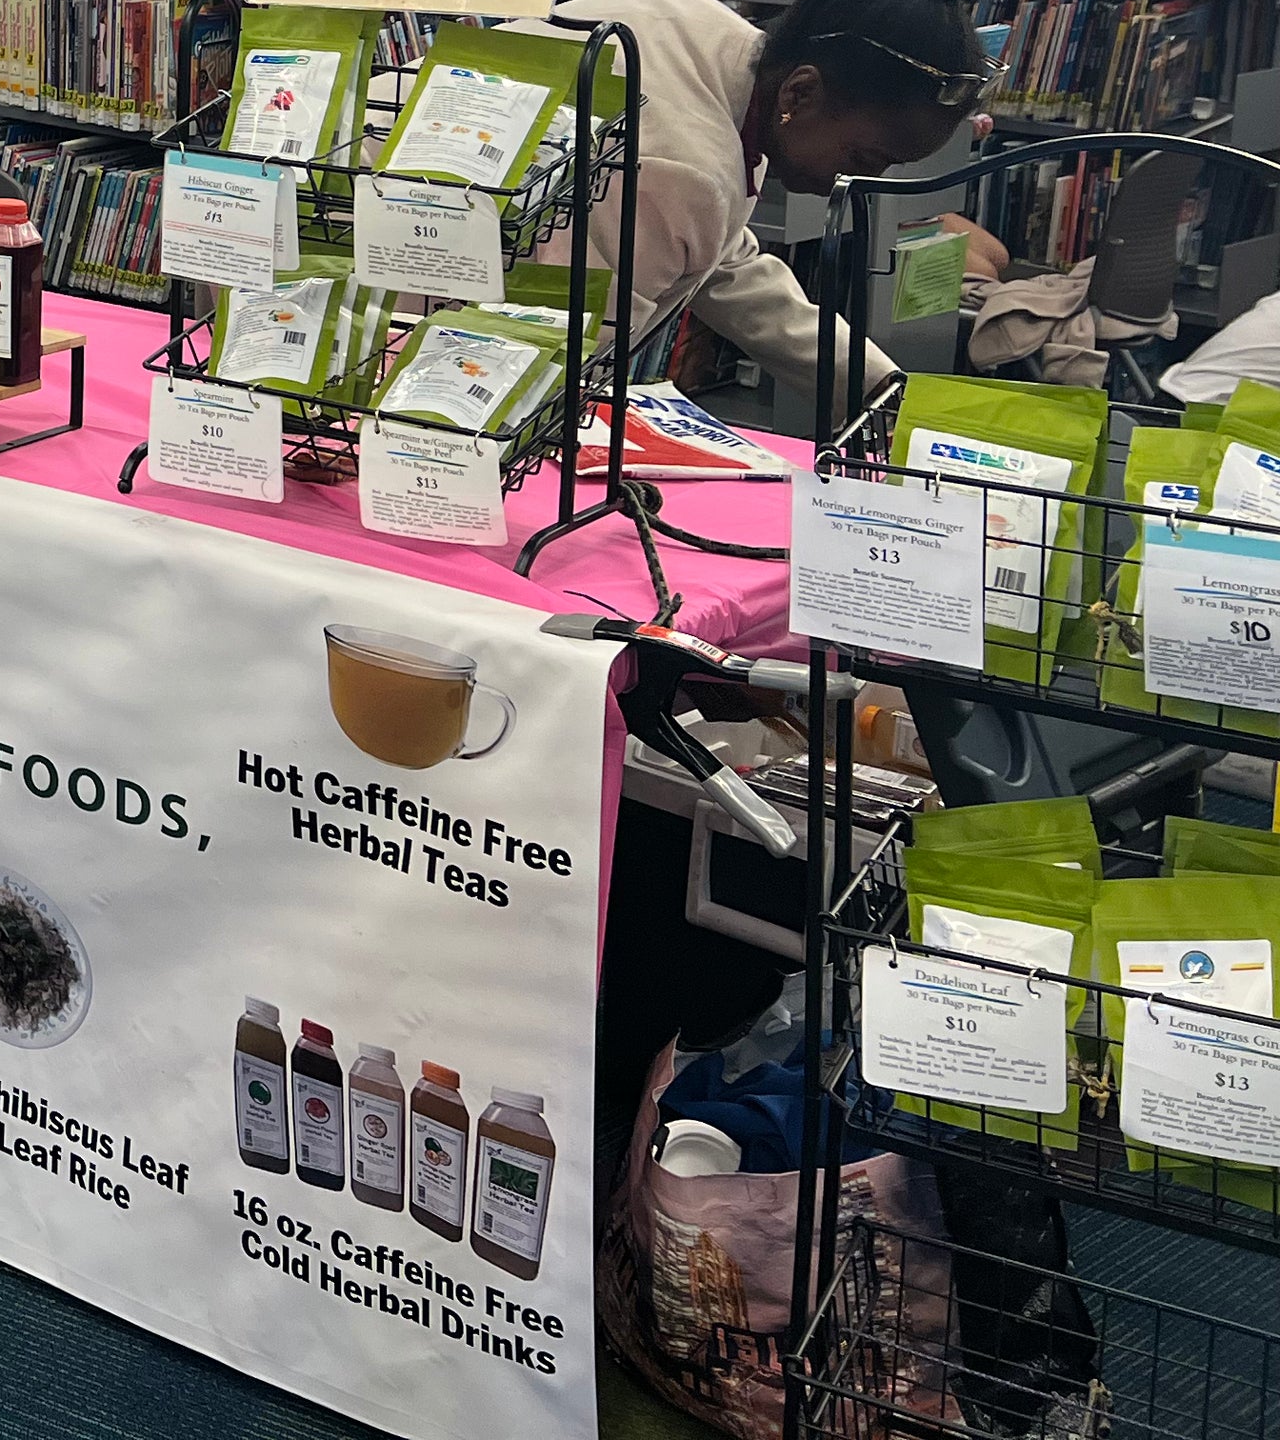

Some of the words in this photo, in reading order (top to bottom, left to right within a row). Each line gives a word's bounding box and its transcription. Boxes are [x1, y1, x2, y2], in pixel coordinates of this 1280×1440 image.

[187, 175, 222, 189] Hibiscus
[224, 181, 254, 195] Ginger
[409, 188, 442, 203] Ginger
[206, 197, 221, 208] Bags
[223, 201, 233, 209] per
[235, 201, 255, 212] Pouch
[396, 206, 409, 214] Tea
[411, 208, 428, 219] Bags
[430, 211, 441, 219] per
[443, 212, 467, 221] Pouch
[204, 210, 222, 223] $13
[414, 225, 438, 239] $10
[194, 388, 234, 404] Spearmint
[187, 404, 199, 413] Tea
[201, 407, 215, 418] Bags
[217, 411, 227, 419] per
[229, 413, 249, 422] Pouch
[202, 425, 223, 438] $10
[381, 428, 421, 444] Spearmint
[423, 437, 463, 452] w/Ginger
[465, 444, 473, 452] &
[401, 442, 431, 456] Orange
[434, 448, 452, 459] Peel
[400, 459, 412, 468] Tea
[413, 462, 429, 472] Bags
[430, 466, 441, 474] per
[443, 467, 464, 476] Pouch
[416, 476, 438, 489] $13
[812, 497, 856, 515] Moringa
[860, 506, 922, 526] Lemongrass
[925, 517, 964, 534] Ginger
[831, 521, 843, 531] 30
[845, 524, 863, 535] Tea
[867, 527, 889, 541] Bags
[892, 532, 908, 543] per
[910, 535, 941, 549] Pouch
[869, 547, 901, 564] $13
[1202, 576, 1280, 597] Lemongrass
[1181, 595, 1194, 605] 30
[1197, 597, 1217, 608] Tea
[1220, 601, 1245, 615] Bags
[1248, 606, 1266, 616] per
[1230, 620, 1271, 642] $10
[237, 749, 304, 801] Hot
[314, 766, 473, 847] Caffeine
[482, 822, 574, 878] Free
[290, 807, 413, 872] Herbal
[423, 851, 510, 909] Teas
[915, 968, 978, 992] Dandelion
[982, 981, 1011, 997] Leaf
[906, 989, 920, 999] 30
[921, 991, 939, 1004] Tea
[942, 996, 965, 1010] Bags
[967, 1001, 983, 1013] per
[986, 1004, 1017, 1018] Pouch
[945, 1015, 977, 1033] $10
[1169, 1015, 1249, 1045] Lemongrass
[1253, 1034, 1280, 1051] Gin
[1172, 1040, 1186, 1050] 30
[1189, 1044, 1209, 1057] Tea
[1212, 1049, 1237, 1064] Bags
[1240, 1057, 1258, 1068] per
[1261, 1058, 1280, 1071] Pou
[1214, 1071, 1250, 1091] $13
[122, 1136, 191, 1196] Leaf
[69, 1152, 130, 1209] Rice
[232, 1189, 269, 1227] 16
[276, 1214, 321, 1251] oz.
[330, 1229, 476, 1306] Caffeine
[485, 1287, 564, 1341] Free
[241, 1229, 310, 1284] Cold
[319, 1259, 433, 1334] Herbal
[442, 1300, 556, 1376] Drinks
